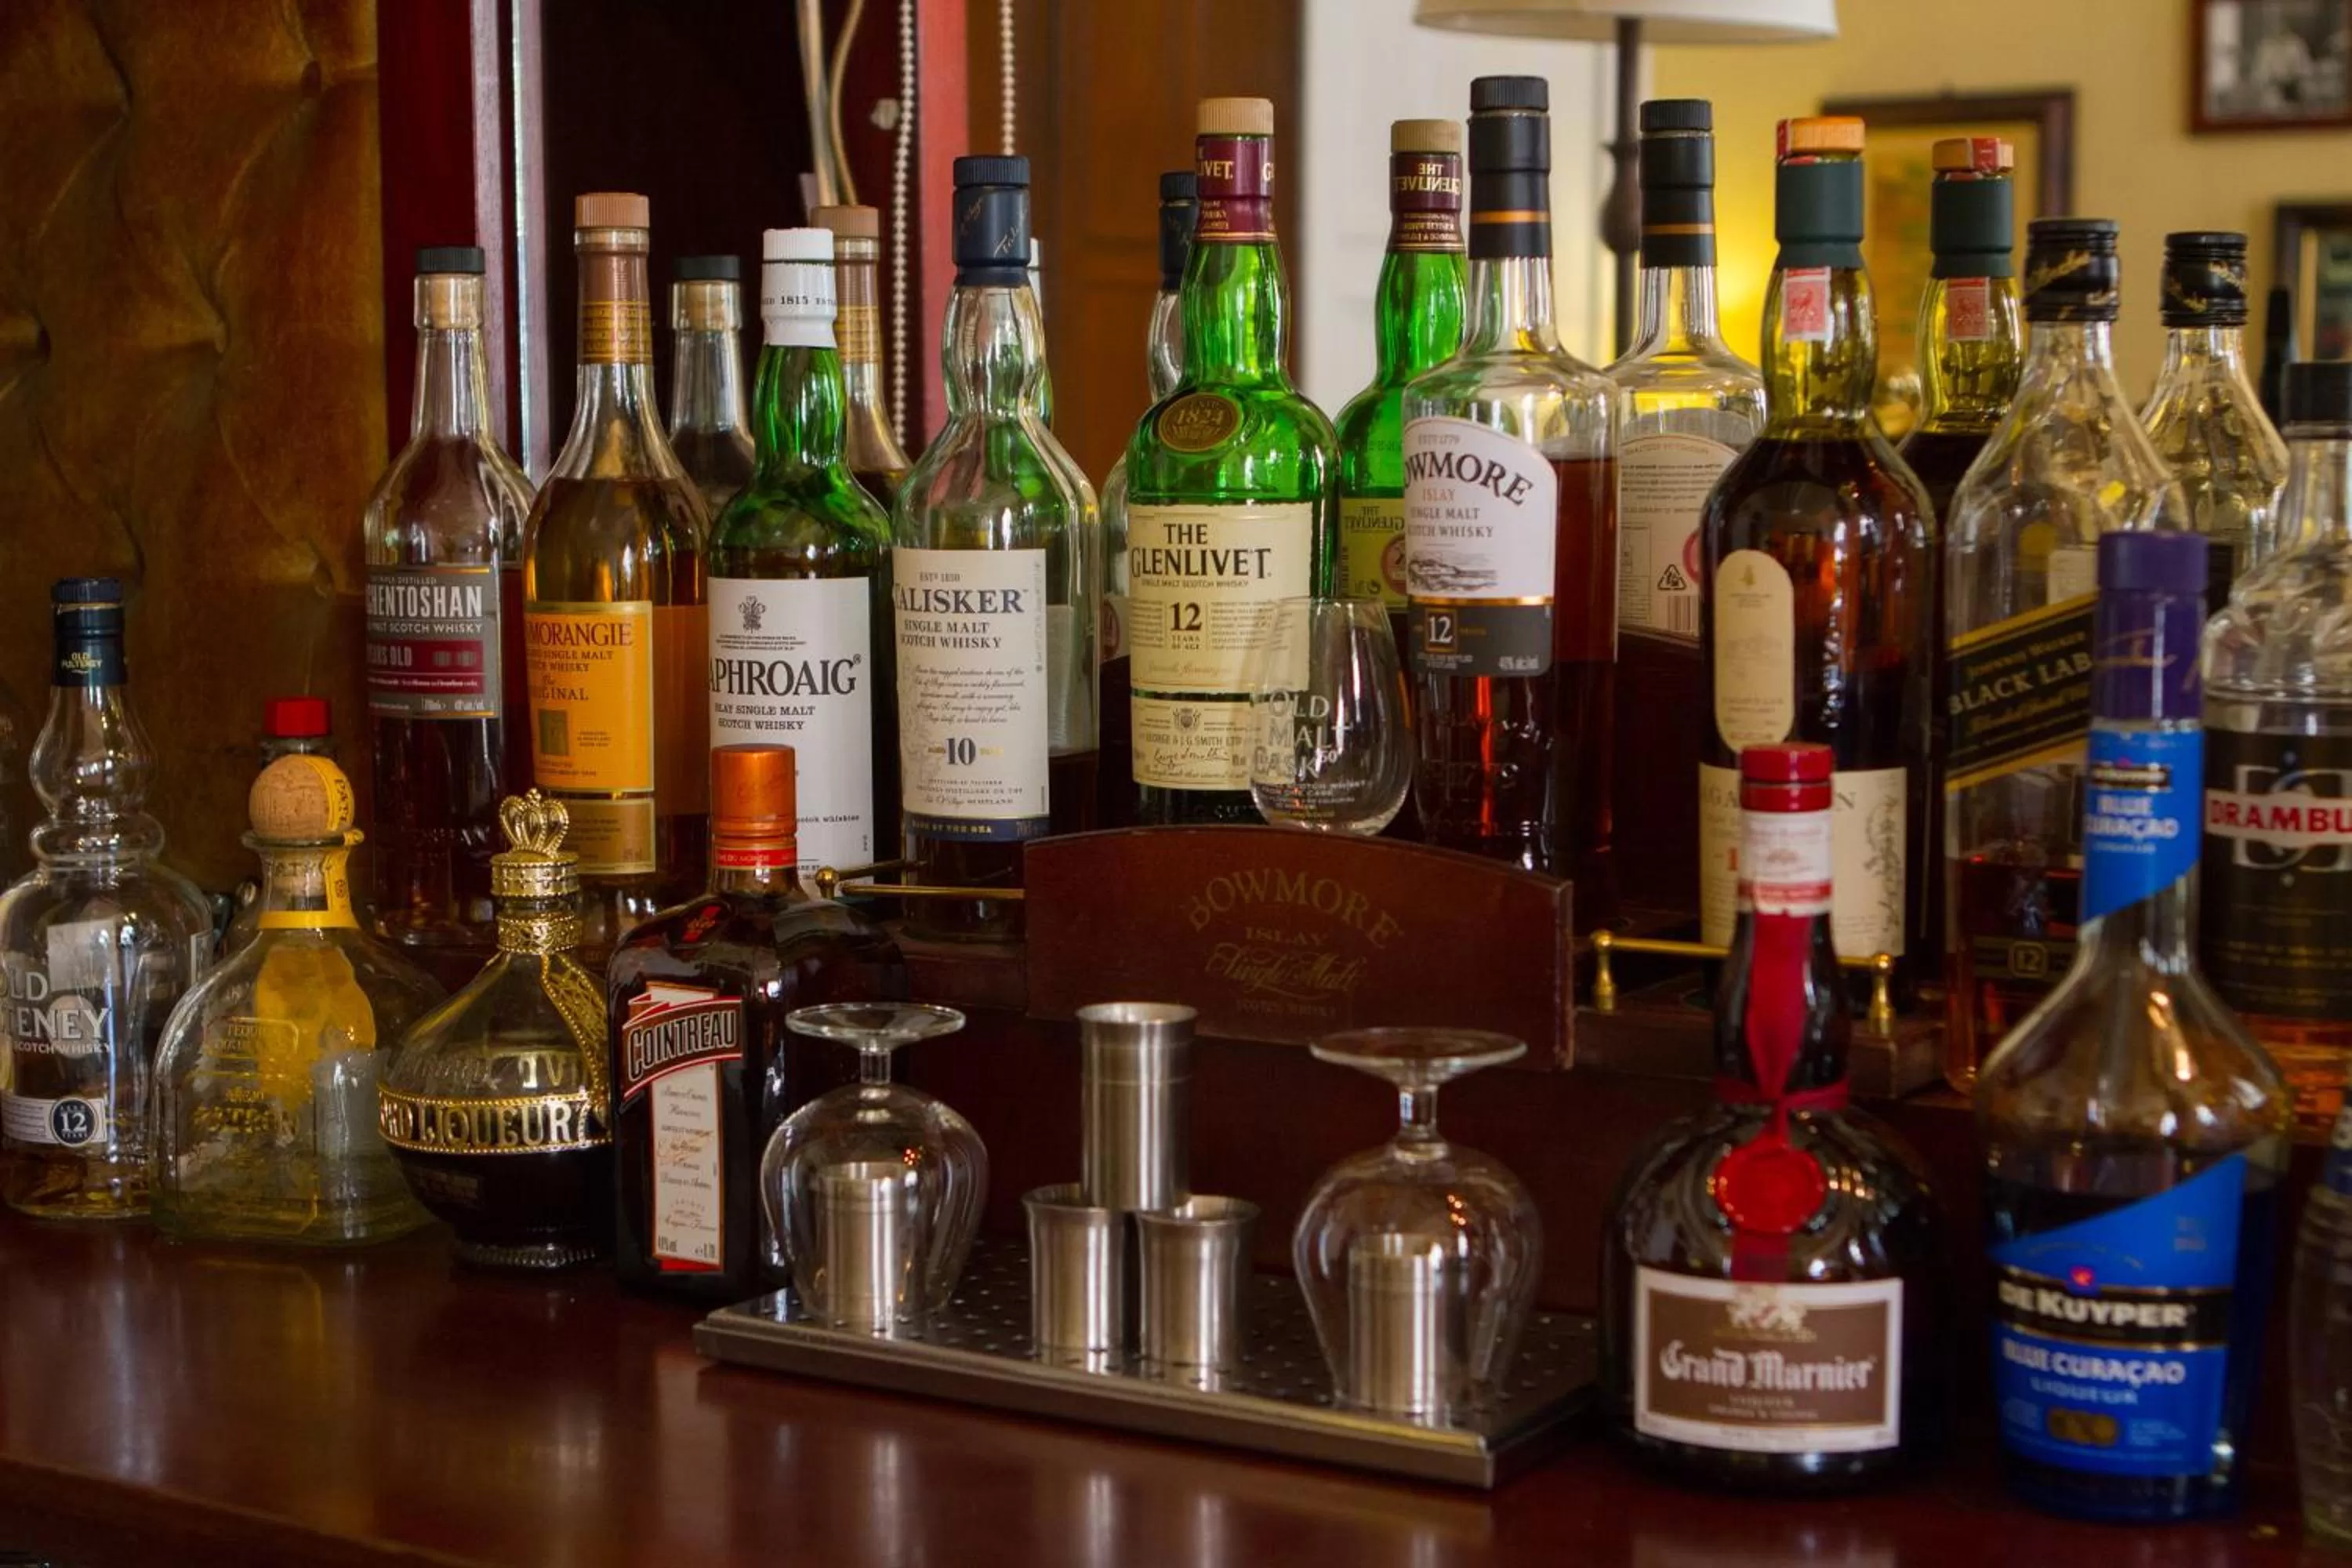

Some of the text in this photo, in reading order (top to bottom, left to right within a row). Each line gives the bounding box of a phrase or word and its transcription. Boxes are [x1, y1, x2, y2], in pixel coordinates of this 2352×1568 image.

[1423, 488, 1456, 503] ISLAY
[1446, 508, 1481, 521] MALT
[1163, 522, 1208, 546] THE
[1439, 525, 1494, 539] WHISKY
[904, 619, 991, 634] SINGLE MALT
[1169, 601, 1203, 631] 12
[433, 624, 483, 633] WHISKY
[1428, 615, 1454, 644] 12
[941, 637, 1002, 649] WHISKY
[390, 646, 412, 666] OLD
[581, 651, 614, 660] MALT
[1947, 670, 2035, 716] BLACK
[735, 705, 777, 716] SINGLE
[779, 706, 816, 716] MALT
[1269, 690, 1331, 719] OLD
[755, 720, 806, 731] WHISKY
[946, 737, 977, 766] 10
[1189, 867, 1406, 949] BOWMORE
[628, 1009, 738, 1083] COINTREAU
[60, 1112, 88, 1133] 12
[2038, 1287, 2188, 1327] KUYPER
[1658, 1338, 1875, 1392] Grand Marnier
[2051, 1350, 2187, 1390] CURAÇAO
